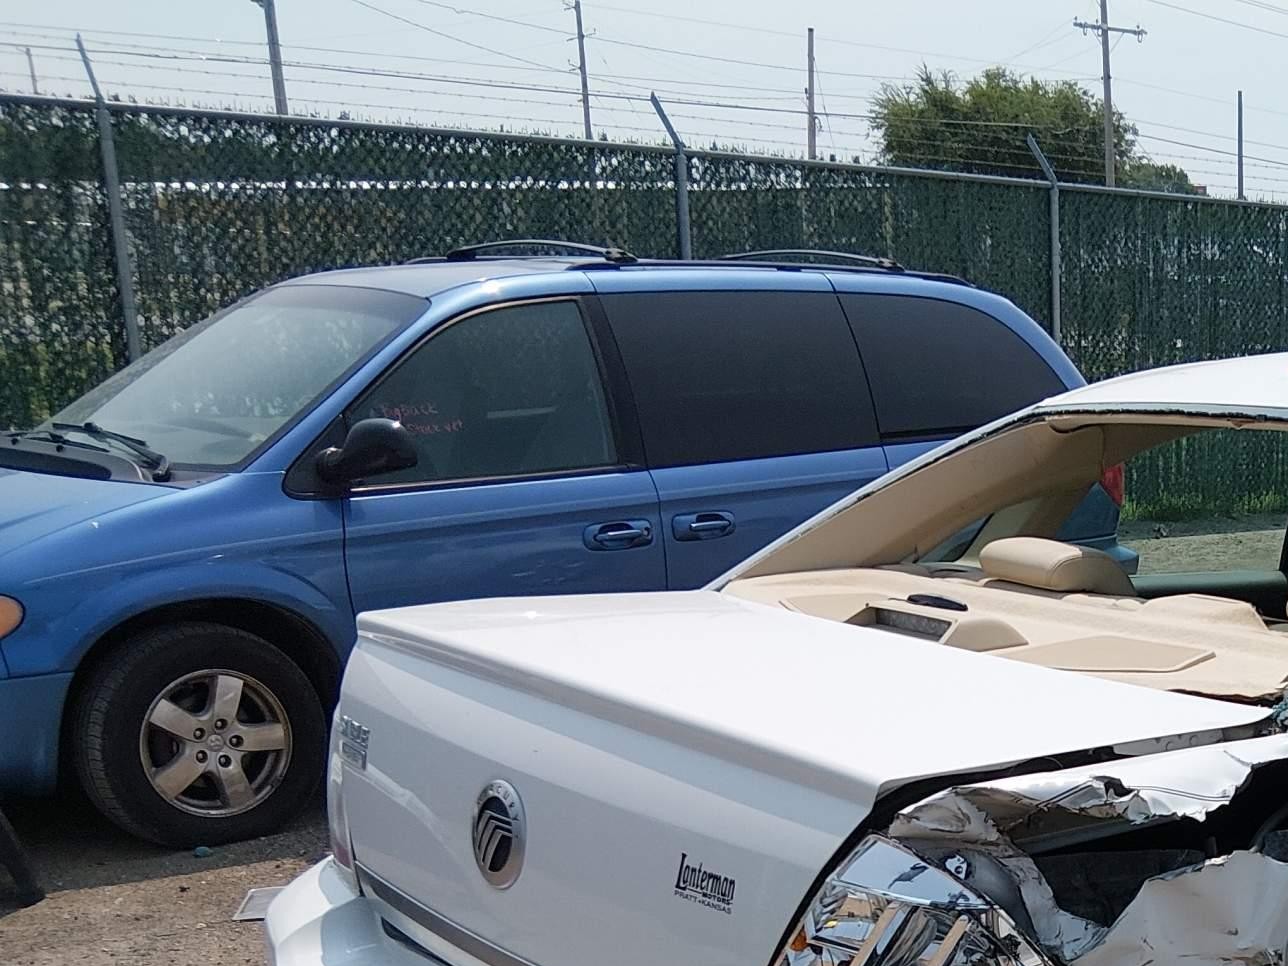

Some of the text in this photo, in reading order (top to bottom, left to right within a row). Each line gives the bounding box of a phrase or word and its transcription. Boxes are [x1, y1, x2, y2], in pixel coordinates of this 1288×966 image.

[675, 852, 736, 901] Lanterman
[674, 889, 732, 915] PRATT KANSAS
[701, 892, 733, 906] MOTORS
